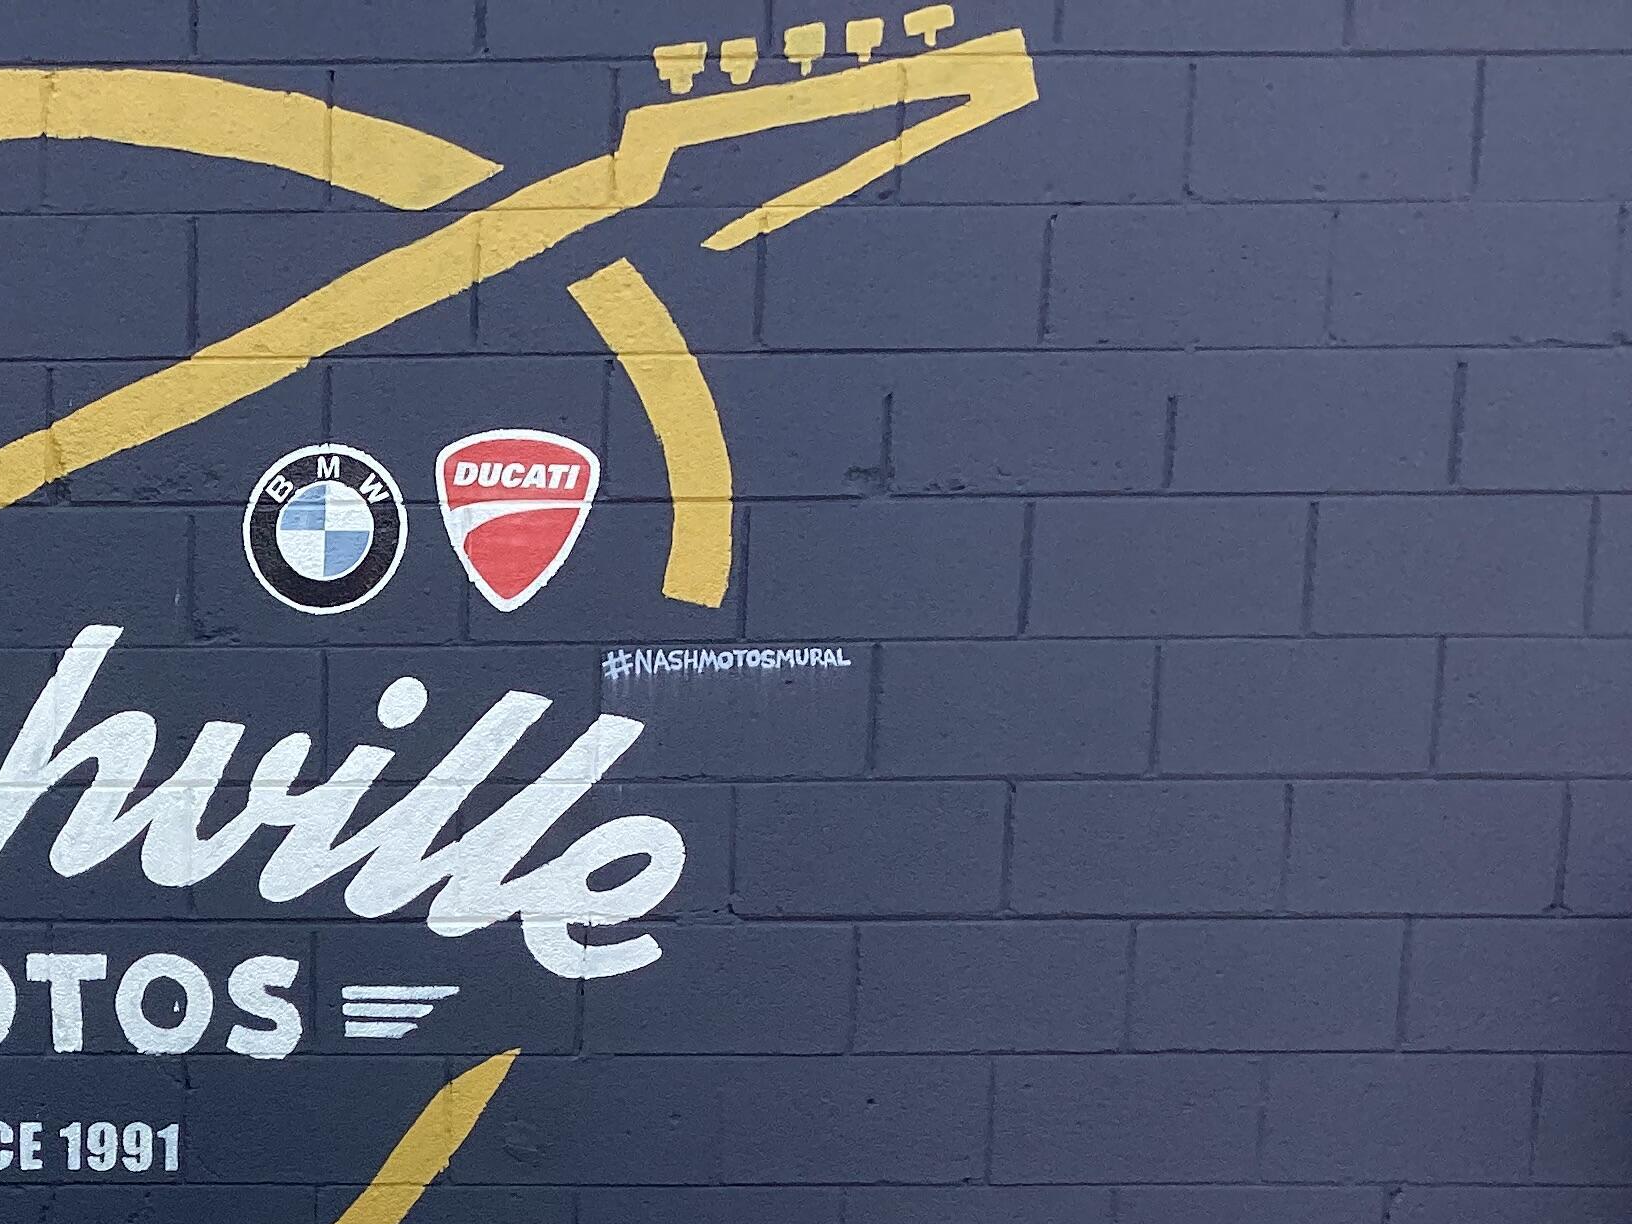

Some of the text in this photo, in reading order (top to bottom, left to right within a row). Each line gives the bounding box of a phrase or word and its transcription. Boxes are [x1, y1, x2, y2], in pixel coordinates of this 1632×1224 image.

[265, 455, 390, 504] BMW
[453, 461, 581, 490] DUCATI
[601, 647, 853, 683] #NASHMOTOSMURAL
[59, 1121, 180, 1172] 1991
